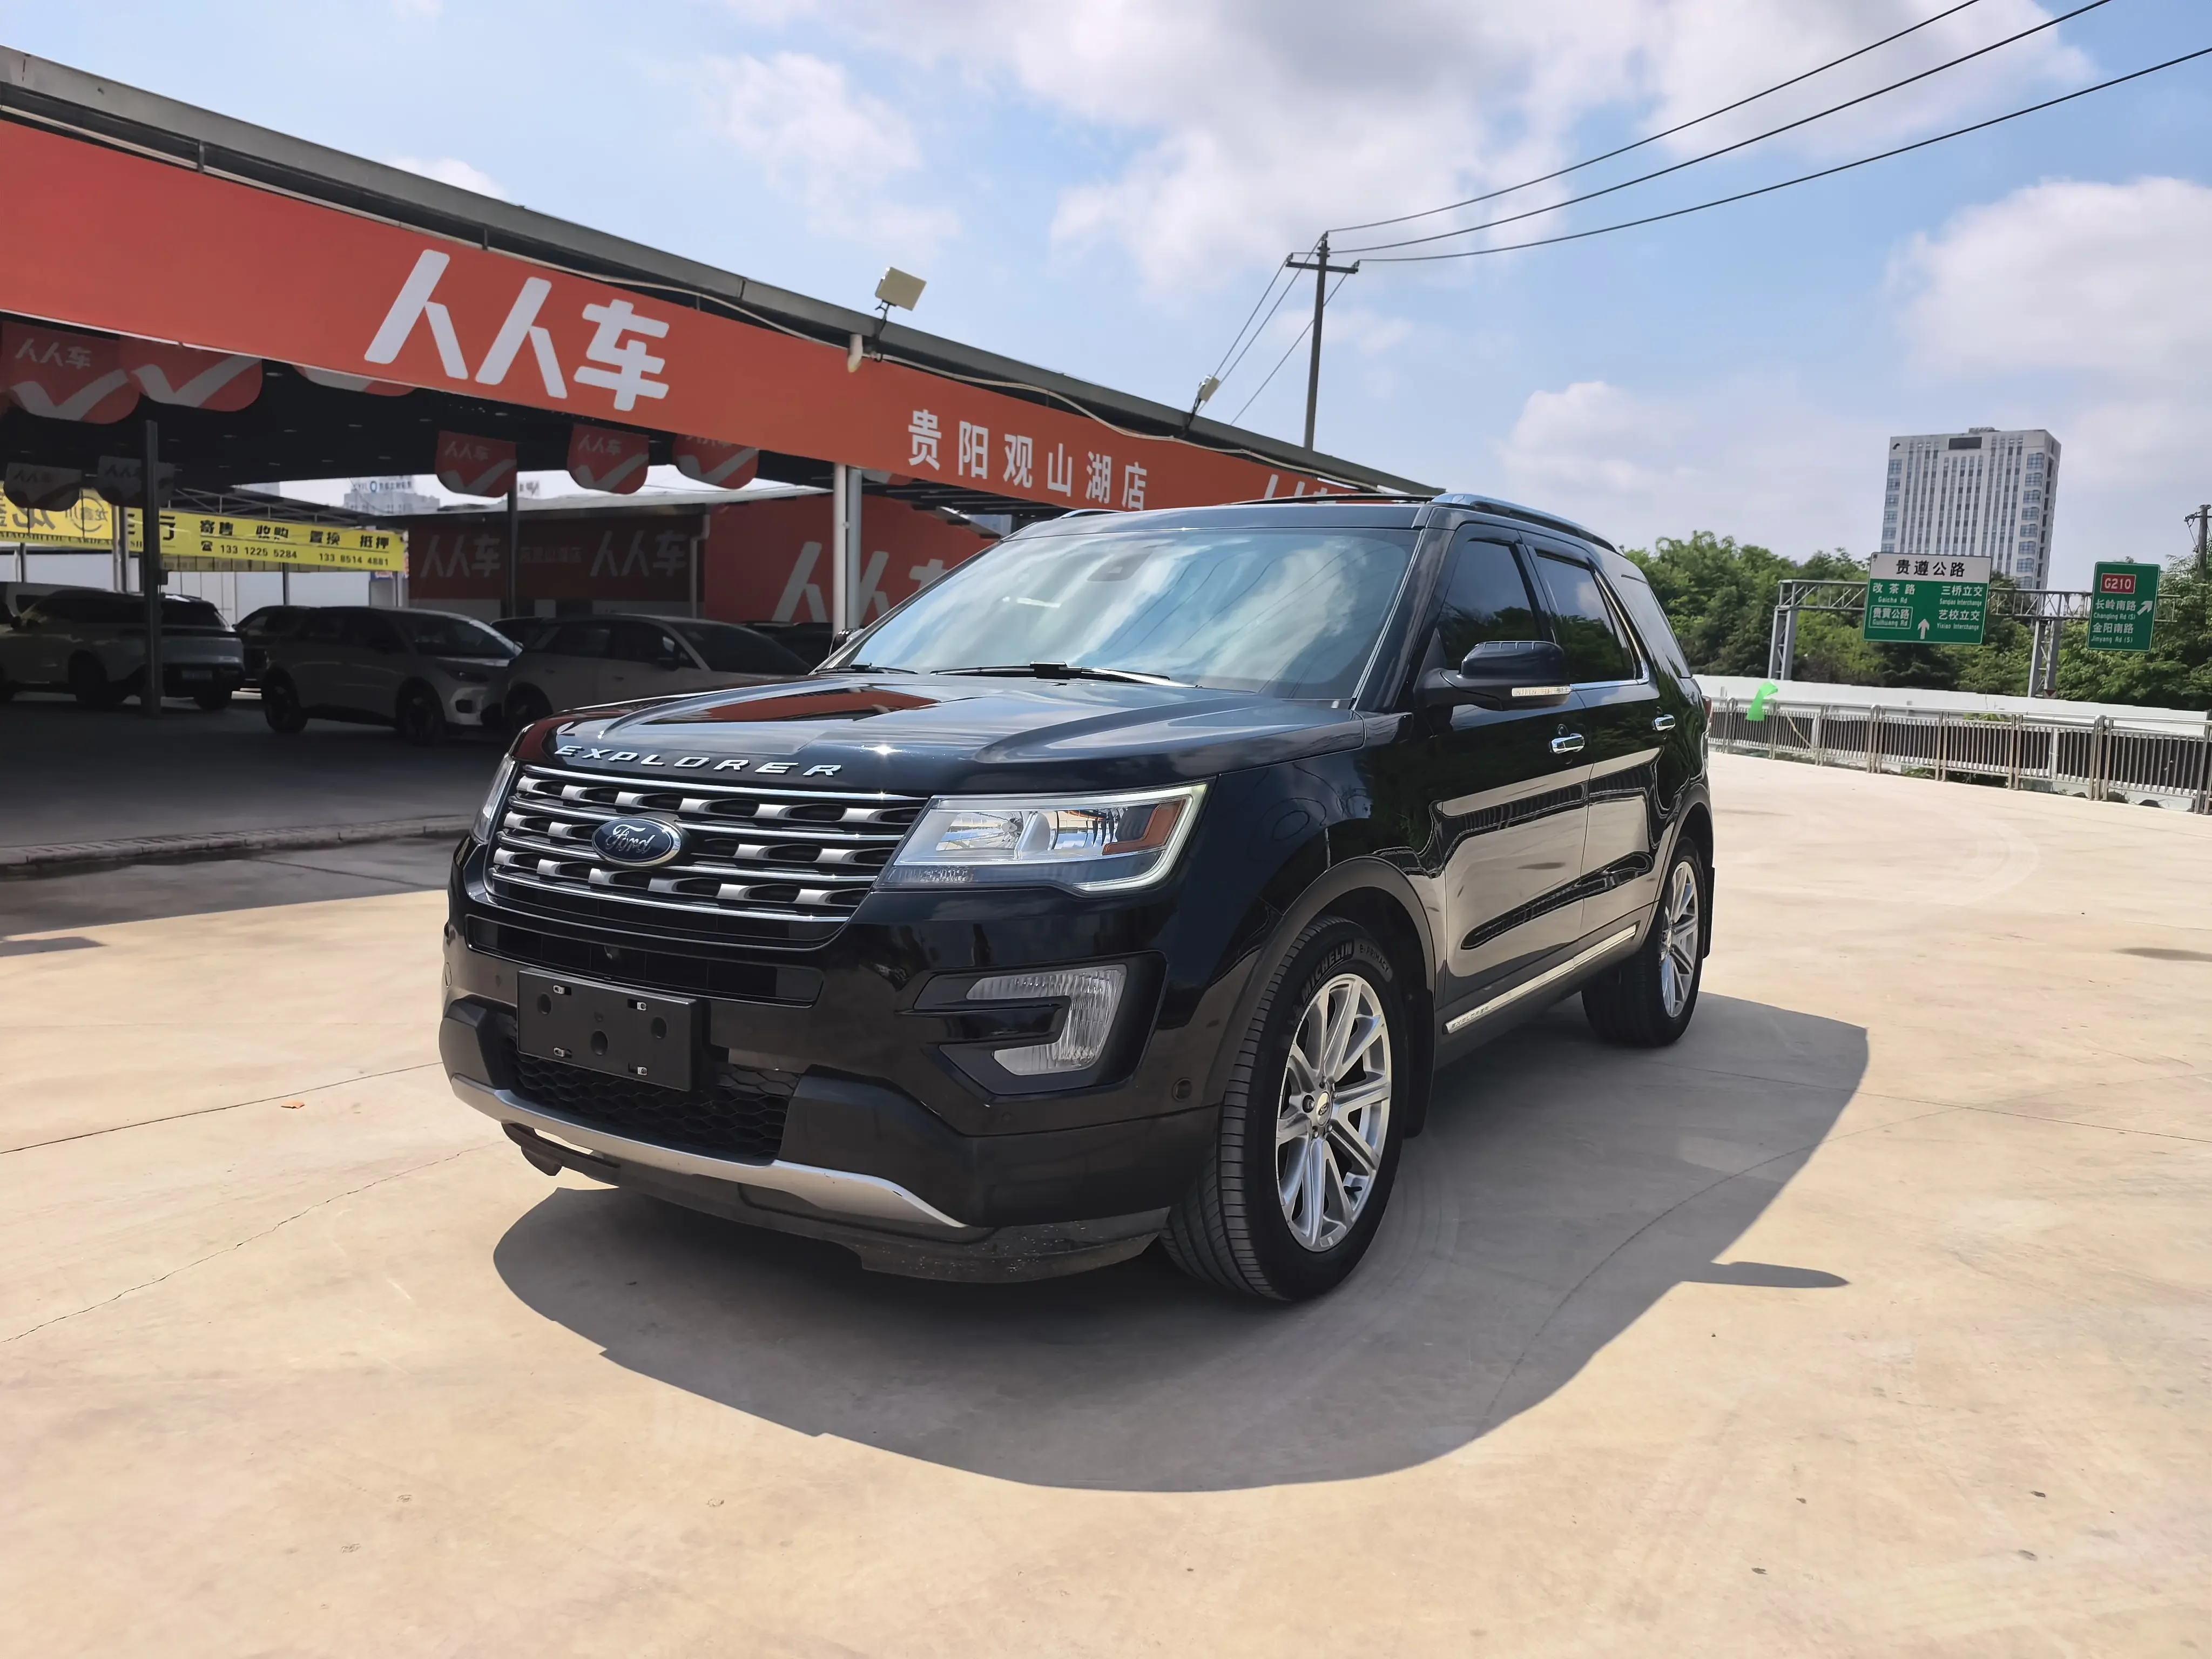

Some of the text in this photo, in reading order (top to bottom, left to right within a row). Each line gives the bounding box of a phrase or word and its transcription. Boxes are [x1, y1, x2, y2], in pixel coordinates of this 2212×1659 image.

[364, 248, 670, 412] 人人车
[15, 338, 92, 370] 人人车
[444, 441, 490, 461] 人人车
[578, 434, 622, 456] 人人车
[908, 409, 1148, 510] 贵阳观山湖店
[220, 544, 238, 554] 133
[245, 547, 268, 557] 1225
[273, 549, 298, 559] 5284
[319, 553, 335, 562] 133
[420, 534, 501, 578] 人人车
[590, 529, 689, 577] 人人车
[1896, 559, 1966, 577] 贵遵公路
[1872, 582, 1916, 595] 改茶路
[1941, 585, 1984, 597] 三桥立交
[2104, 578, 2132, 590] G210
[1957, 598, 1982, 608] Interchange
[2095, 598, 2136, 611] 长岭南路
[1938, 609, 1981, 621] 艺校立交
[2093, 612, 2119, 622] Changling
[1953, 623, 1979, 631] Interchange
[2092, 622, 2134, 633] 金阳南路
[2091, 635, 2113, 644] Jinyang
[554, 745, 842, 777] EXPLORER
[605, 824, 655, 853] Ford
[1301, 941, 1352, 1004] MICHELIN
